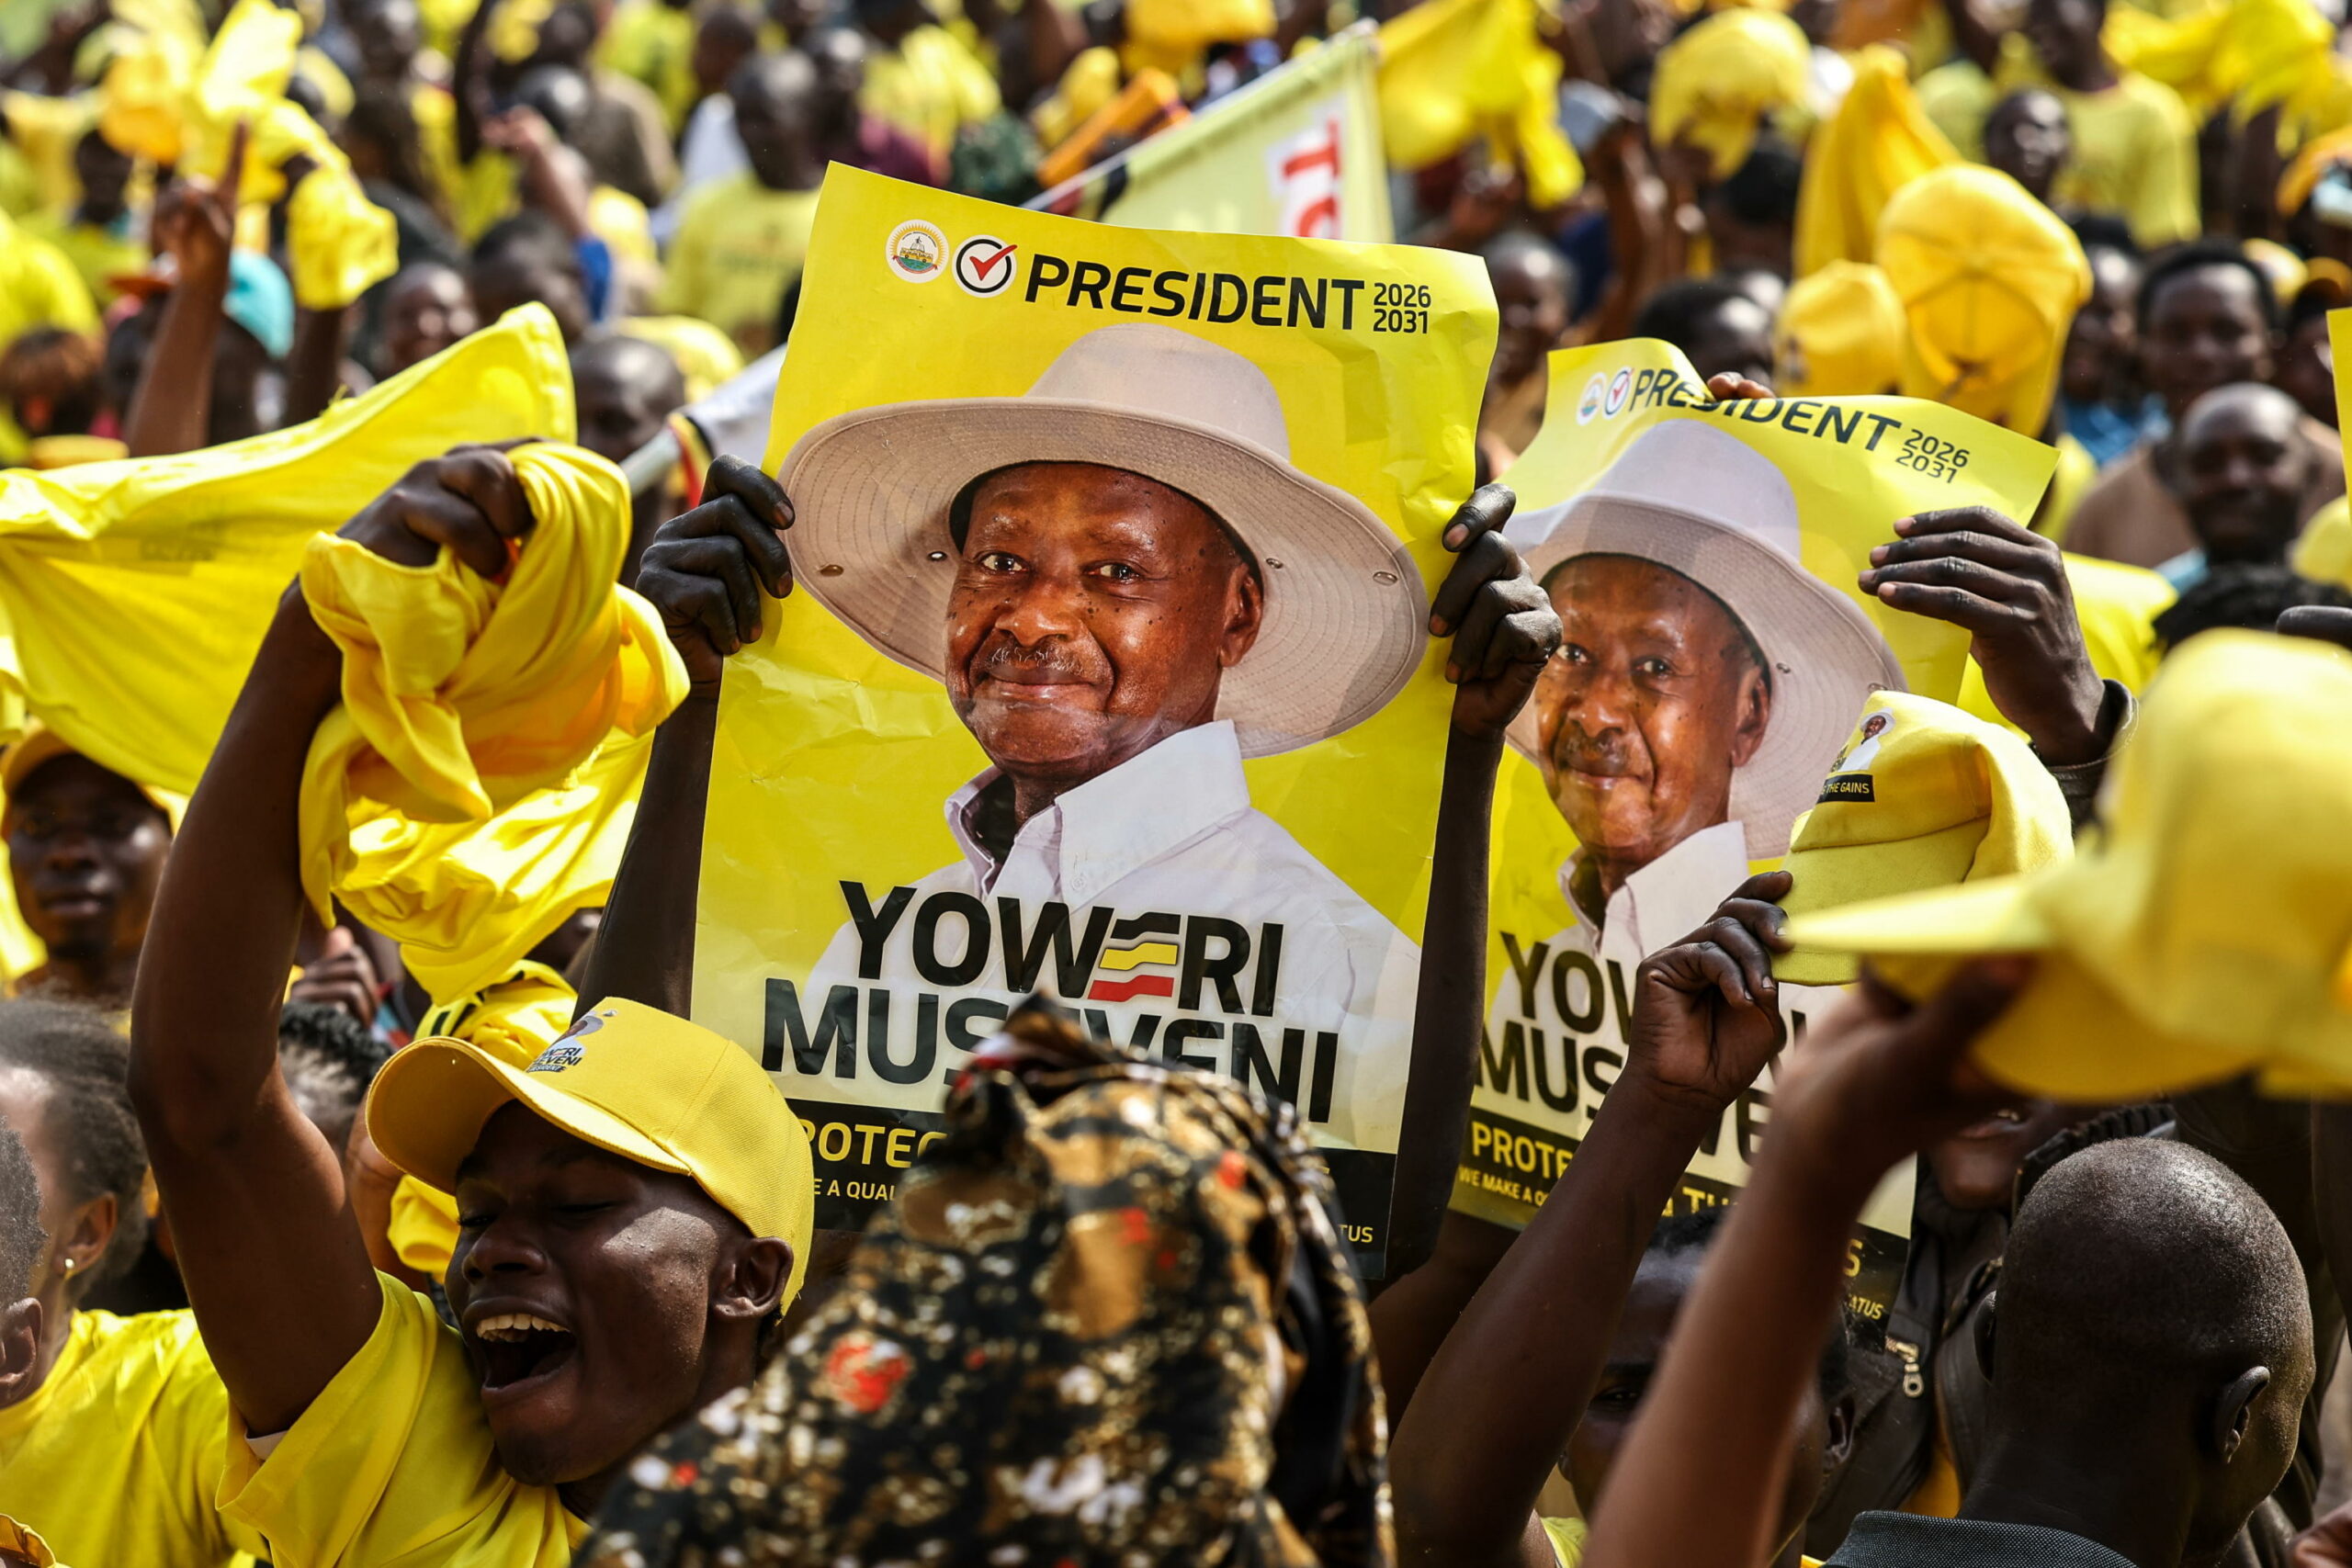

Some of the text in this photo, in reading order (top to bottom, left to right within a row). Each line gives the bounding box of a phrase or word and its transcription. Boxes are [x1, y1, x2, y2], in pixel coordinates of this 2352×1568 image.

[1024, 254, 1365, 331] PRESIDENT
[1373, 282, 1431, 308] 2026
[1373, 308, 1429, 333] 2031
[1904, 429, 1971, 468] 2026
[1895, 449, 1958, 484] 2031
[1840, 782, 1871, 794] GAINS
[762, 977, 1339, 1123] MUSENI
[827, 1179, 841, 1197] A
[1482, 1173, 1521, 1200] MAKE
[1522, 1187, 1532, 1203] A
